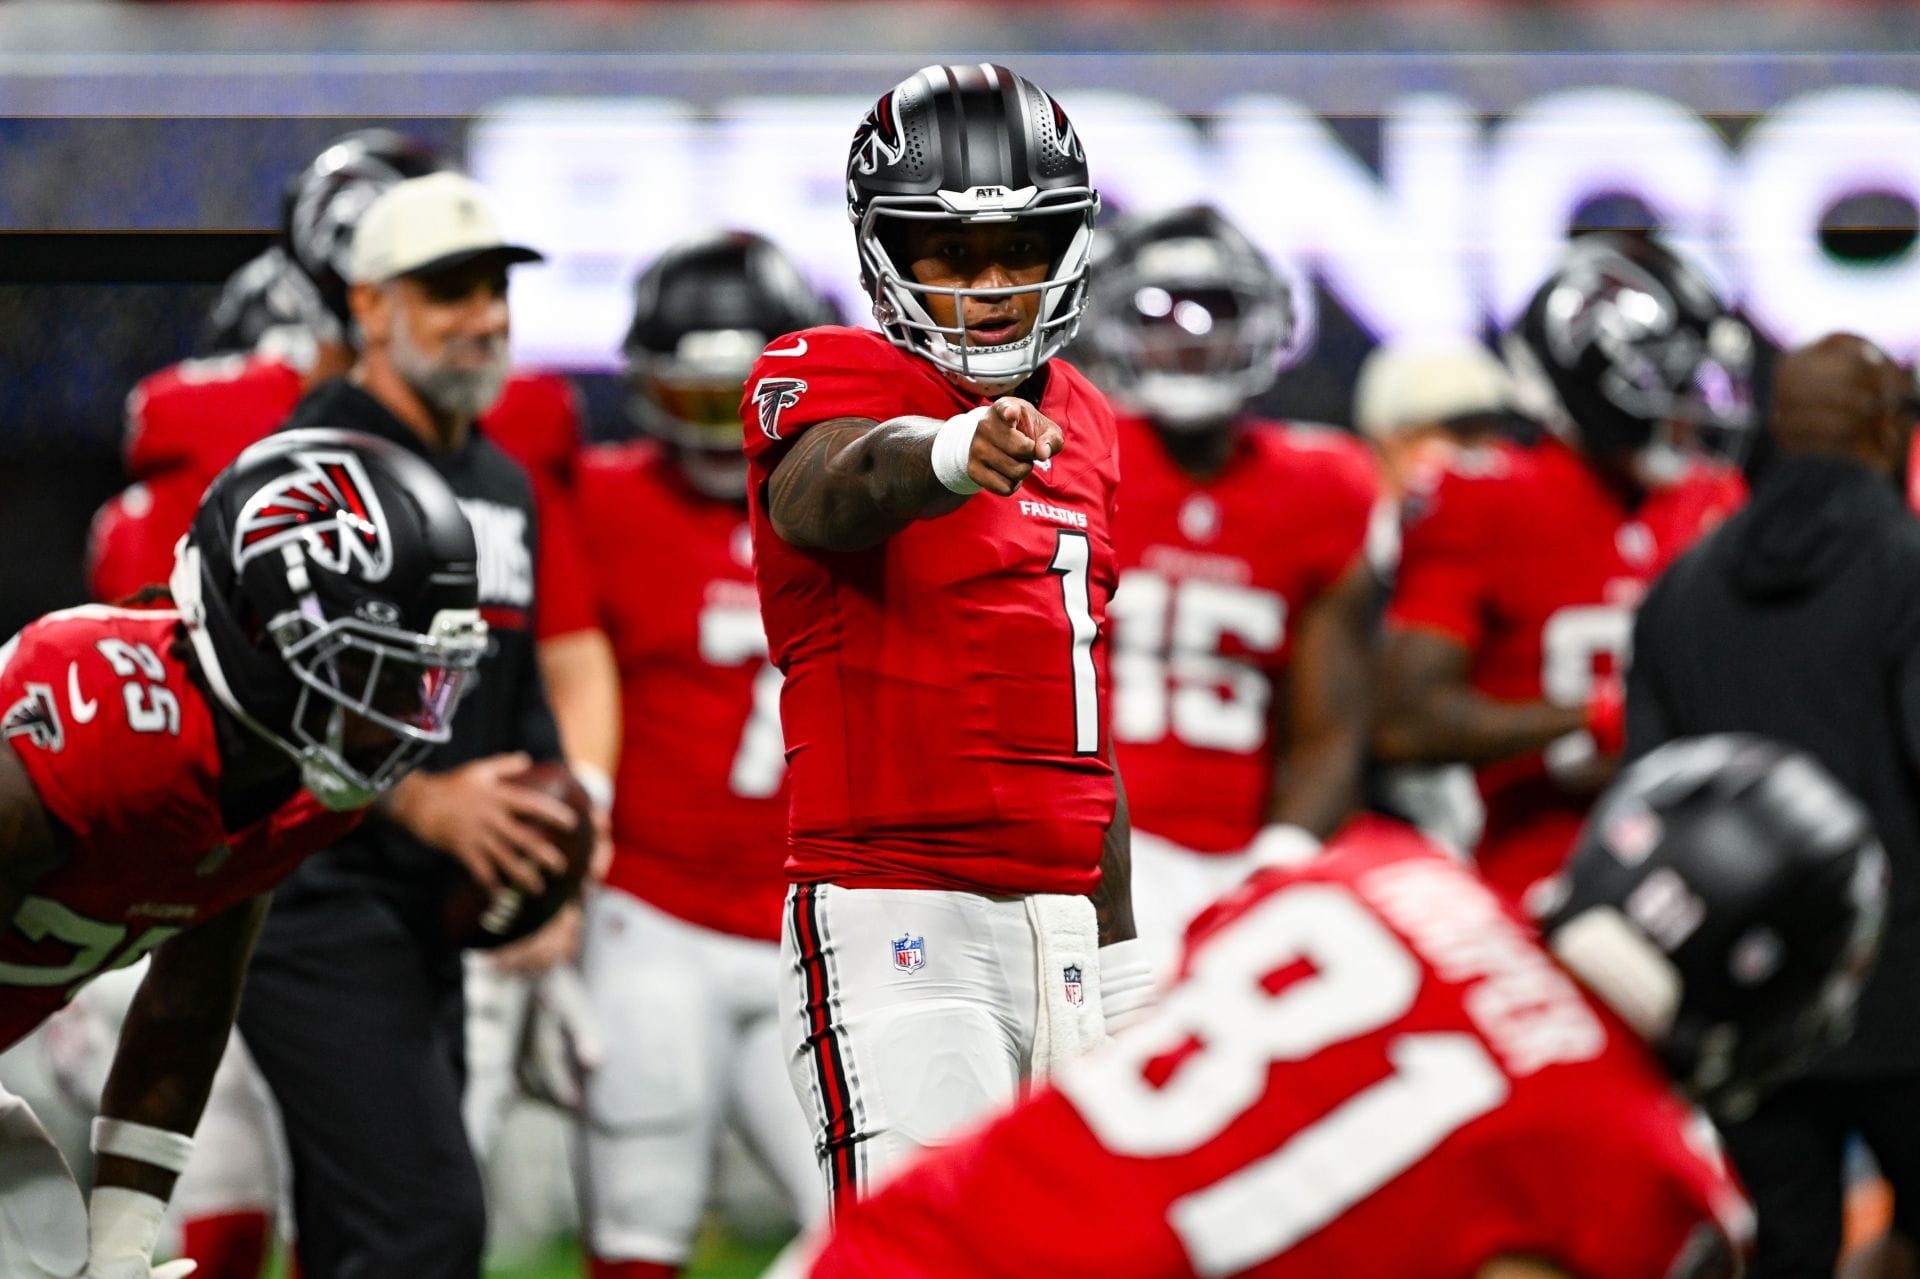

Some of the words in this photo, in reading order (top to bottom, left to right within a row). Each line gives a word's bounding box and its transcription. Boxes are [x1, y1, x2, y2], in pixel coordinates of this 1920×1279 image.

[976, 188, 1004, 199] ATL
[1018, 500, 1088, 528] FALCONS
[96, 636, 181, 736] 25
[1046, 528, 1098, 758] 1
[1104, 568, 1288, 754] 15
[898, 951, 920, 966] NFL
[1060, 882, 1512, 1278] 81
